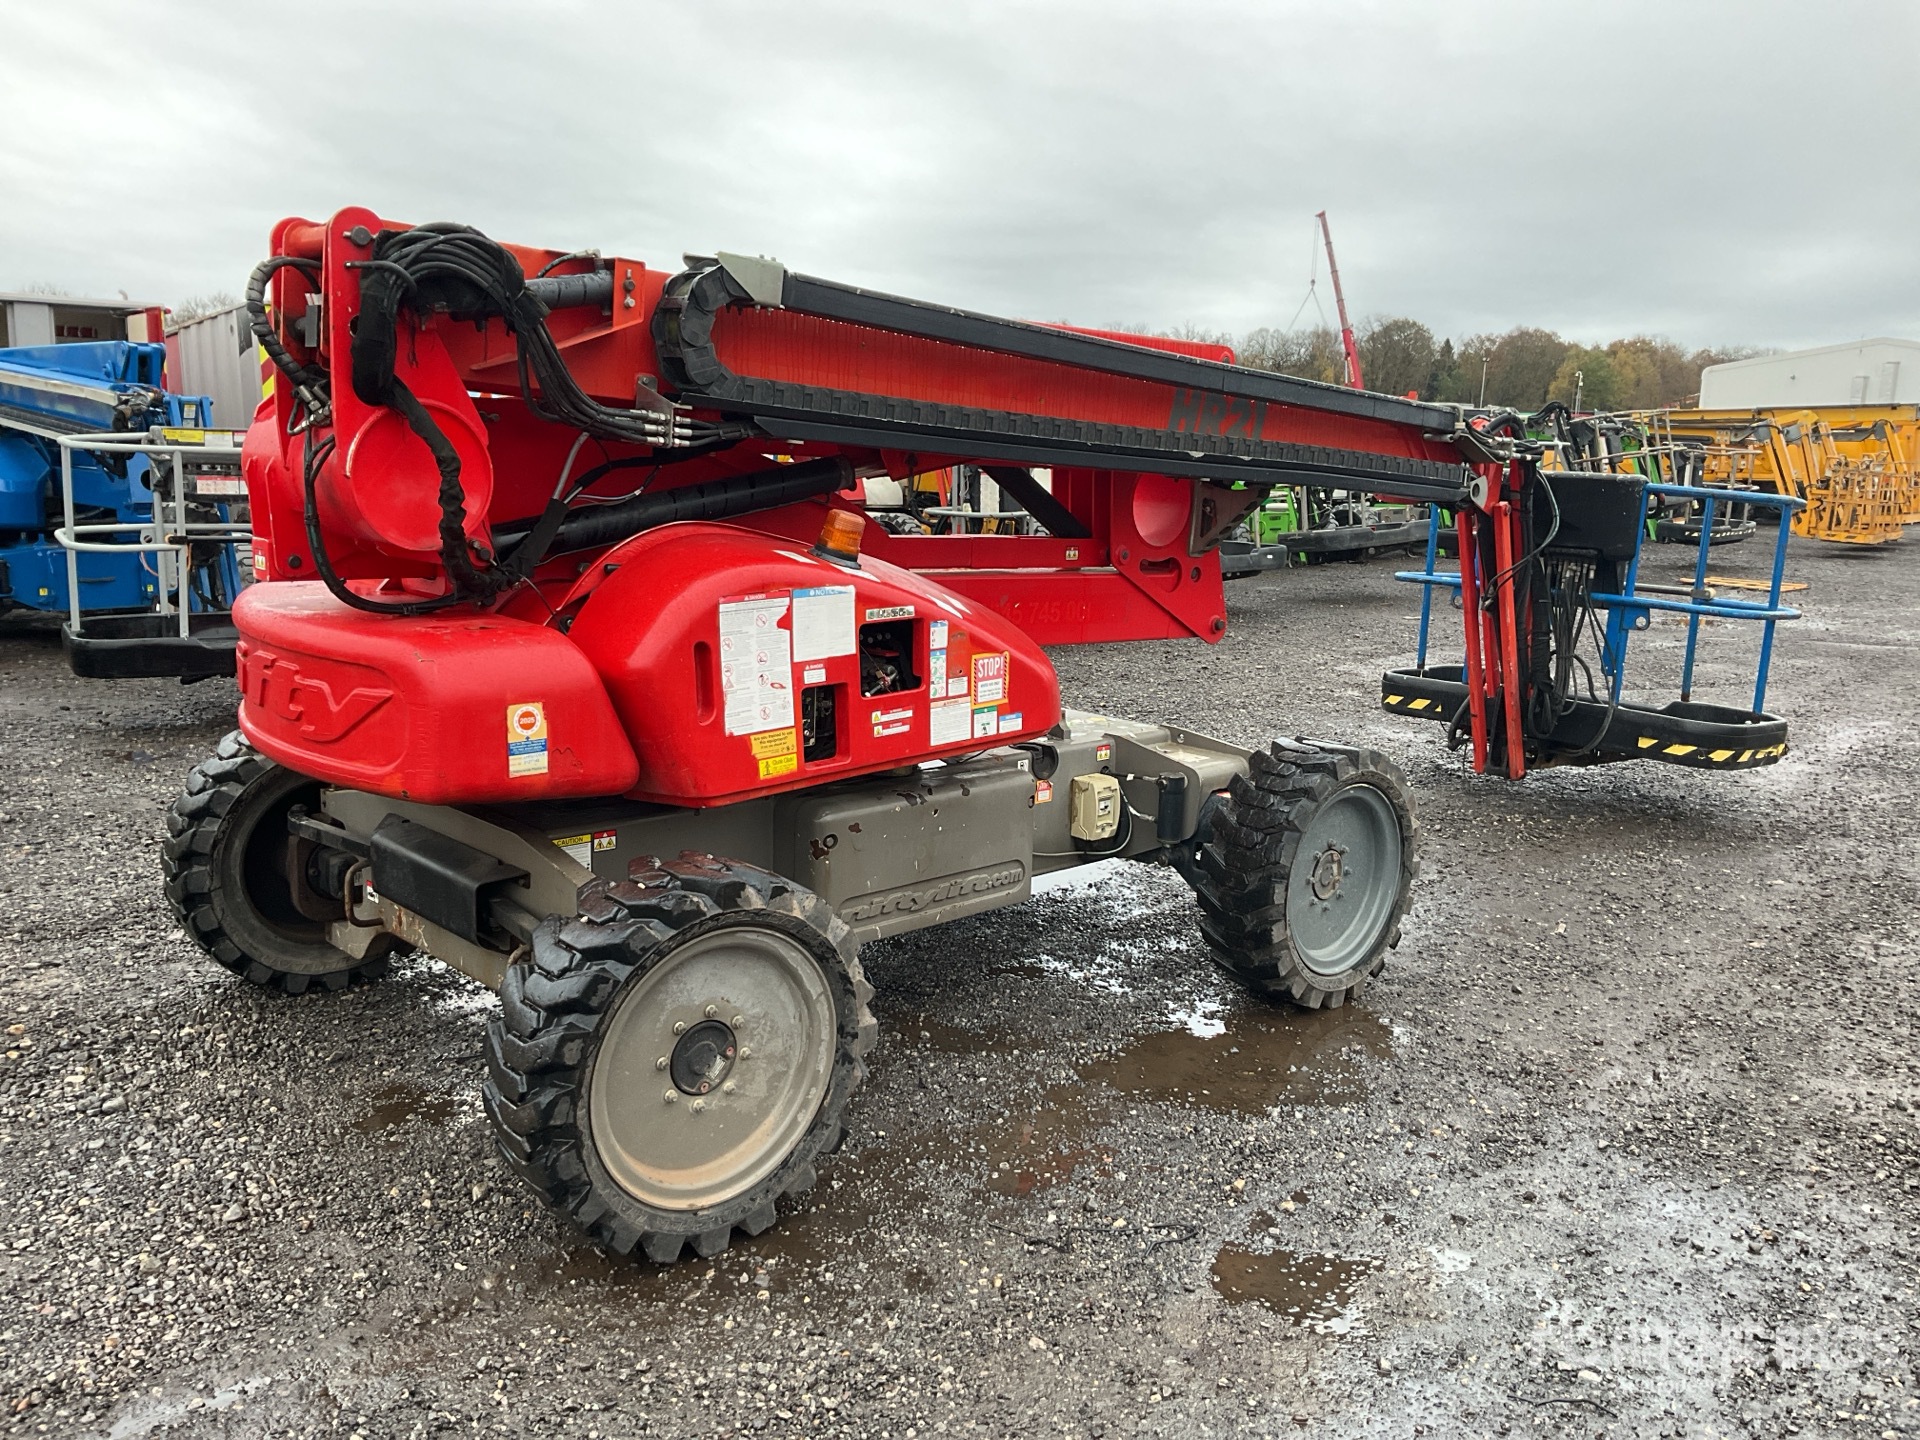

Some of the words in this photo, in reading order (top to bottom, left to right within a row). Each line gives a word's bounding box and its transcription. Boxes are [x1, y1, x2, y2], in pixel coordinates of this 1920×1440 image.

[1168, 388, 1267, 440] HR21
[978, 656, 1004, 679] STOP!
[235, 640, 395, 742] ifty
[519, 716, 535, 725] 2025
[556, 837, 584, 846] CAUTION
[839, 868, 1024, 922] niftylift.com
